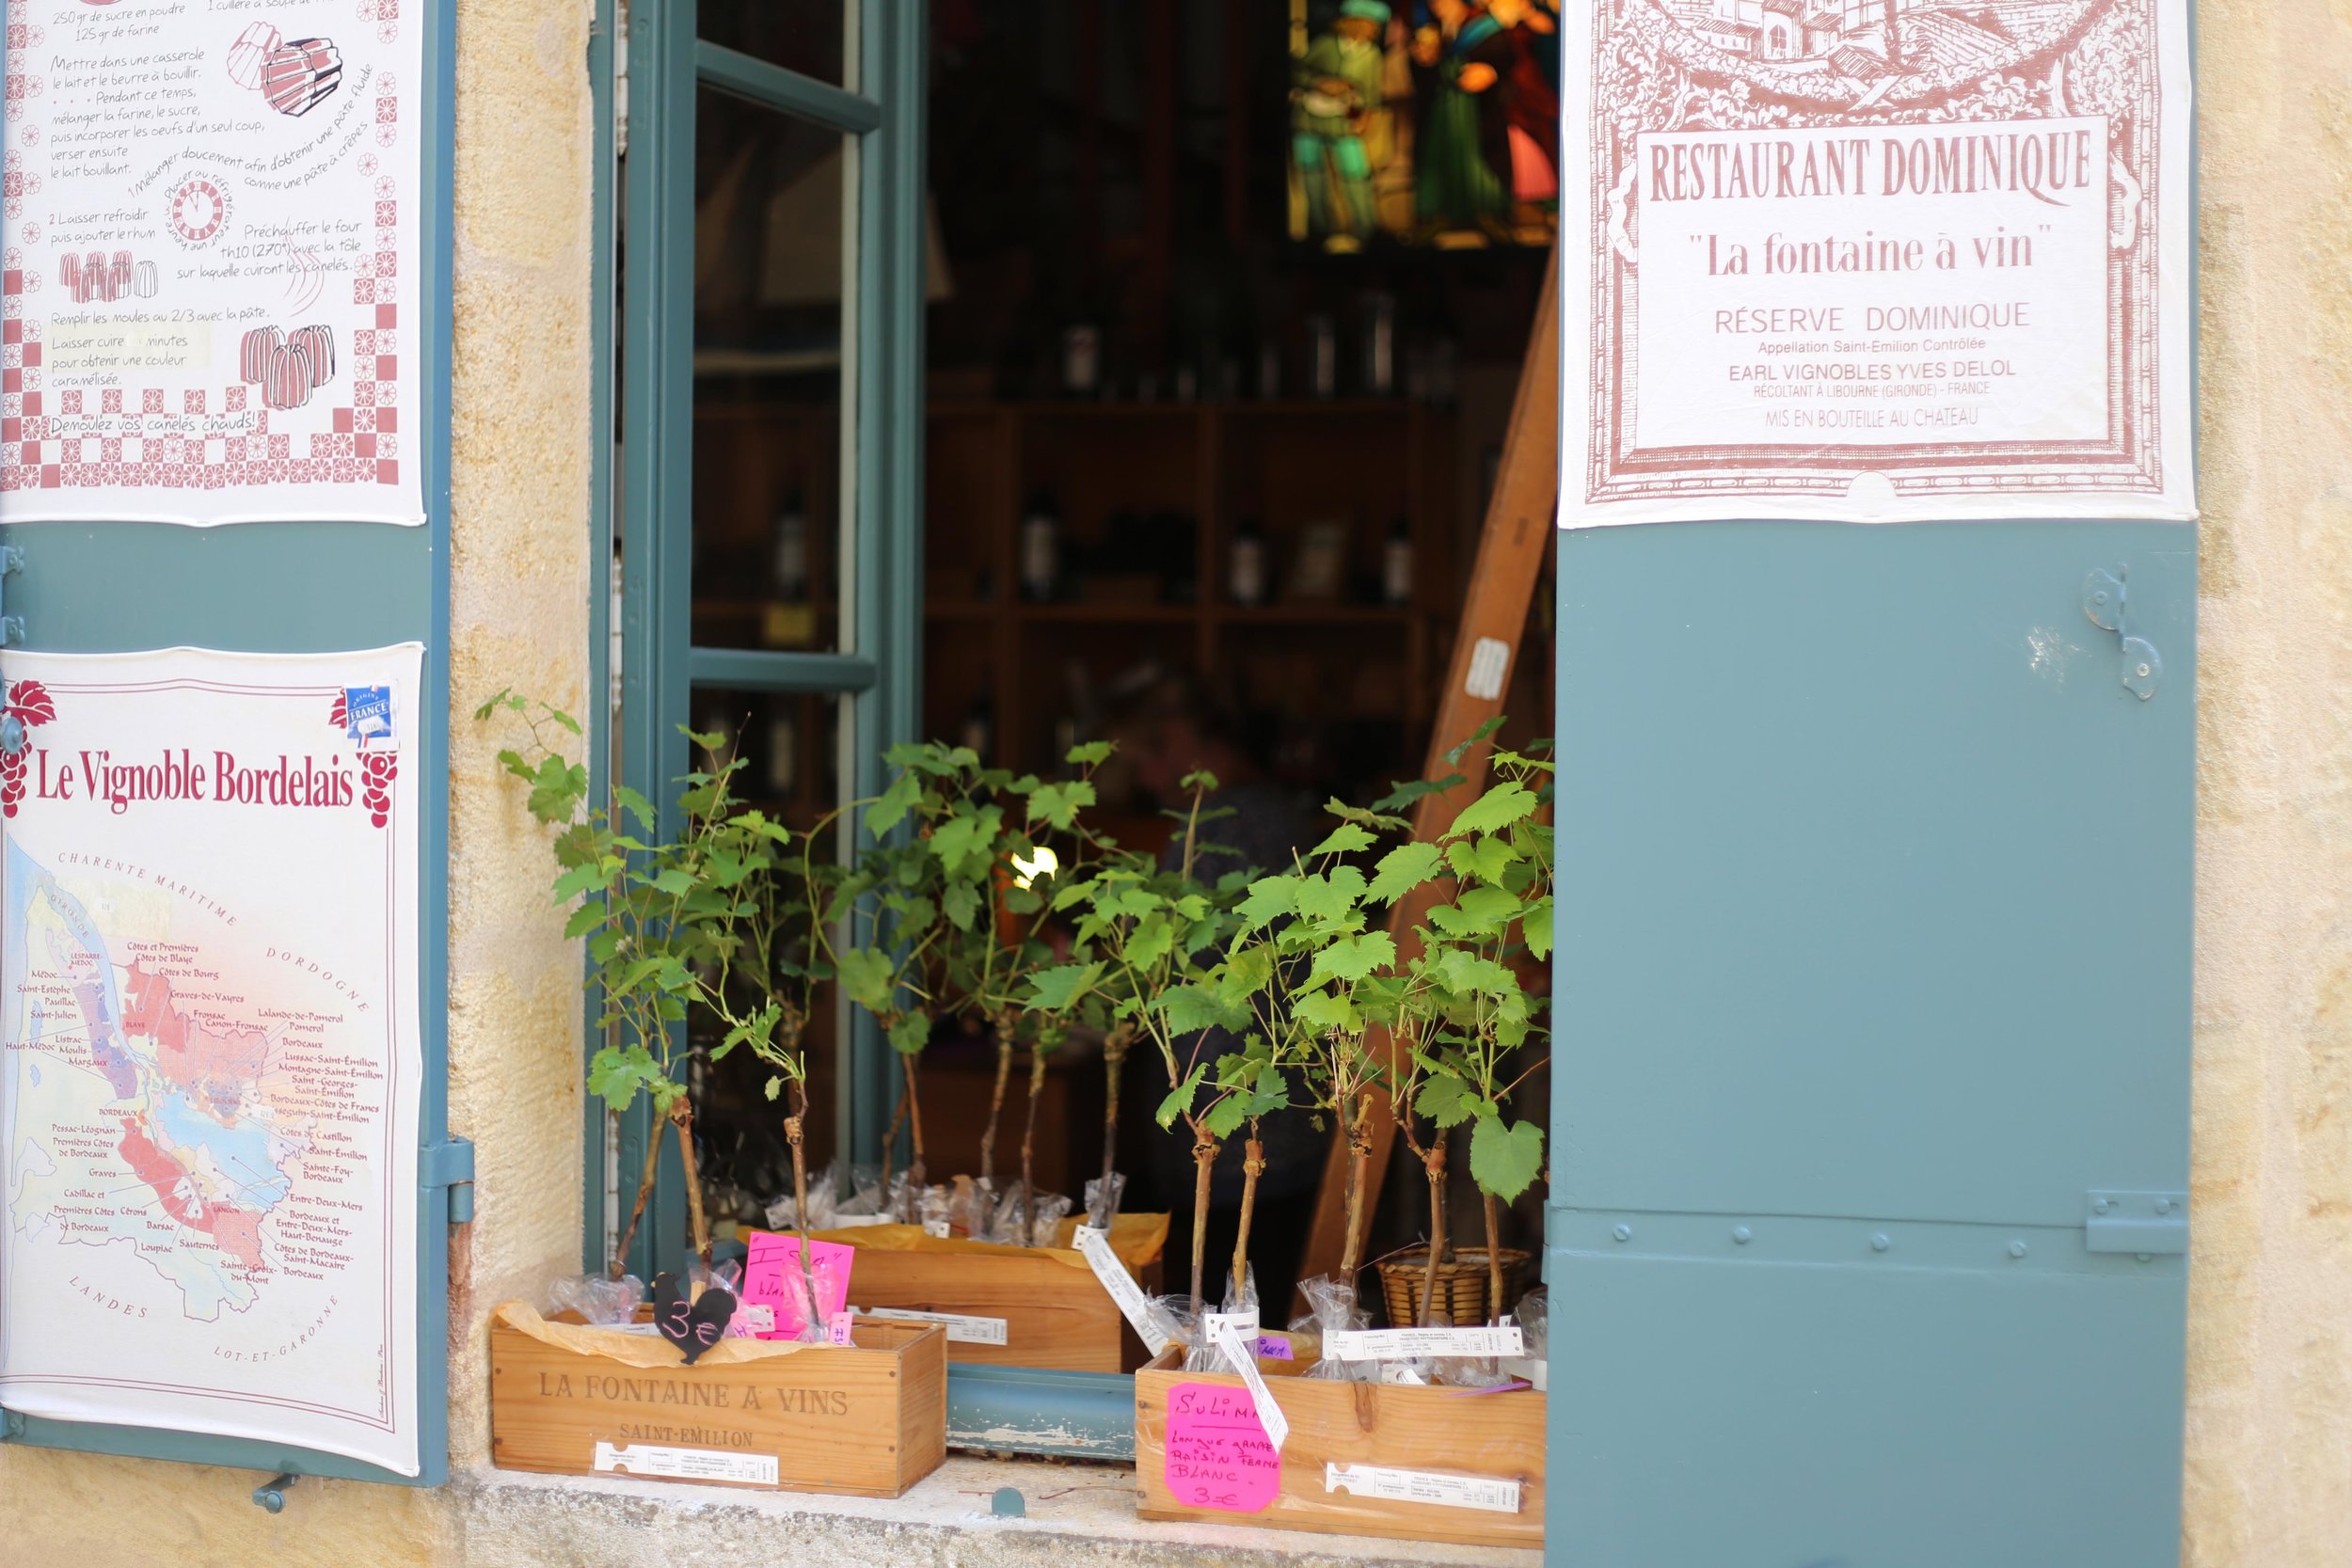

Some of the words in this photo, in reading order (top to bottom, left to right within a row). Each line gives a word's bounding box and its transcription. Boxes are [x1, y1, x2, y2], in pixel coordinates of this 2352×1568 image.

[51, 55, 97, 72] Mettre
[100, 55, 127, 68] dans
[131, 55, 149, 65] une
[152, 46, 204, 62] casserole
[54, 79, 61, 89] le
[64, 75, 81, 88] lait
[84, 76, 96, 87] et
[99, 74, 106, 87] le
[112, 72, 148, 85] beurre
[151, 71, 159, 81] à
[164, 66, 201, 81] bouillir.
[96, 91, 141, 105] Pendant
[144, 90, 156, 100] ce
[161, 87, 196, 102] temps,
[53, 111, 102, 131] mélanger
[104, 109, 114, 122] la
[117, 107, 154, 121] farine,
[157, 105, 167, 118] le
[168, 106, 200, 117] sucre,
[51, 134, 72, 148] puis
[75, 130, 133, 143] incorporer
[134, 125, 148, 137] les
[151, 122, 183, 135] oeufs
[186, 120, 208, 134] d'un
[211, 119, 232, 132] seul
[235, 121, 264, 135] coup,
[51, 150, 86, 161] verser
[88, 147, 128, 158] ensuite
[51, 166, 59, 179] le
[62, 165, 80, 178] lait
[83, 163, 131, 176] bouillant.
[1650, 140, 1870, 204] RESTAURANT
[1882, 130, 2090, 207] DOMINIQUE
[49, 214, 56, 225] 2
[58, 212, 100, 225] Laisser
[103, 208, 149, 222] refroidir
[51, 233, 72, 247] puis
[75, 230, 114, 245] ajouter
[117, 228, 128, 240] le
[128, 229, 155, 239] rhum
[245, 220, 317, 240] Préchauffer
[322, 220, 331, 234] le
[334, 219, 361, 233] four
[1691, 234, 1748, 277] "La
[1762, 231, 1925, 275] fontaine
[1935, 232, 1957, 271] à
[1973, 223, 2052, 269] vin"
[51, 311, 91, 329] Remplir
[93, 310, 107, 324] les
[112, 309, 150, 324] moules
[152, 312, 167, 322] au
[171, 309, 196, 323] 2/3
[197, 310, 223, 322] avec
[226, 306, 237, 319] la
[239, 306, 270, 323] pâte.
[1715, 306, 1844, 334] RÉSERVE
[1867, 302, 2030, 332] DOMINIQUE
[52, 336, 92, 350] Laisser
[97, 336, 124, 347] cuire
[146, 335, 188, 347] minutes
[1757, 341, 1829, 356] Appellation
[1834, 336, 1918, 353] Saint-Émilion
[1922, 337, 1985, 352] Contrôlée
[52, 357, 79, 373] pour
[81, 352, 118, 367] obtenir
[122, 356, 142, 366] une
[145, 352, 185, 366] couleur
[1729, 365, 1777, 381] EARL
[1783, 362, 1891, 380] VIGNOBLES
[1899, 360, 1947, 378] YVES
[1953, 359, 2016, 376] DELOL
[52, 372, 121, 388] caramélisée.
[1754, 382, 1814, 398] RÉCOLTANT
[1826, 383, 1878, 397] LIBOURNE
[1882, 382, 1937, 400] (GIRONDE)
[1947, 381, 1990, 395] FRANCE
[118, 418, 141, 431] vos
[148, 415, 196, 432] canelés
[202, 411, 255, 431] chauds!
[1766, 410, 1791, 428] MIS
[1794, 409, 1813, 428] EN
[1819, 408, 1884, 428] BOUTEILLE
[1890, 409, 1909, 426] AU
[350, 702, 387, 721] FRANCE
[36, 749, 73, 800] Le
[79, 749, 205, 815] Vignoble
[213, 752, 353, 806] Bordelais
[57, 851, 146, 879] CHARENTE
[154, 874, 238, 927] MARITIME
[31, 970, 57, 979] Médoc
[266, 947, 369, 1011] DORDOGNE
[45, 998, 76, 1006] Pauillac
[194, 1009, 226, 1020] Fronsac
[289, 1022, 324, 1033] Pomerol
[59, 1046, 87, 1054] Moulis
[282, 1037, 323, 1049] Bordeaux
[69, 1058, 107, 1067] Margaux
[339, 1101, 348, 1110] de
[351, 1103, 379, 1113] Francs
[89, 1168, 117, 1178] Graves
[303, 1172, 342, 1183] Bordeaux
[147, 1221, 174, 1231] Barsac
[290, 1211, 329, 1223] Bordeaux
[141, 1243, 172, 1254] Loupiac
[180, 1239, 219, 1251] Sauternes
[298, 1247, 308, 1256] de
[284, 1267, 324, 1280] Bordeaux
[69, 1275, 149, 1319] LANDES
[539, 1372, 573, 1399] LA
[585, 1375, 730, 1409] FONTAINE
[777, 1388, 849, 1417] VINS
